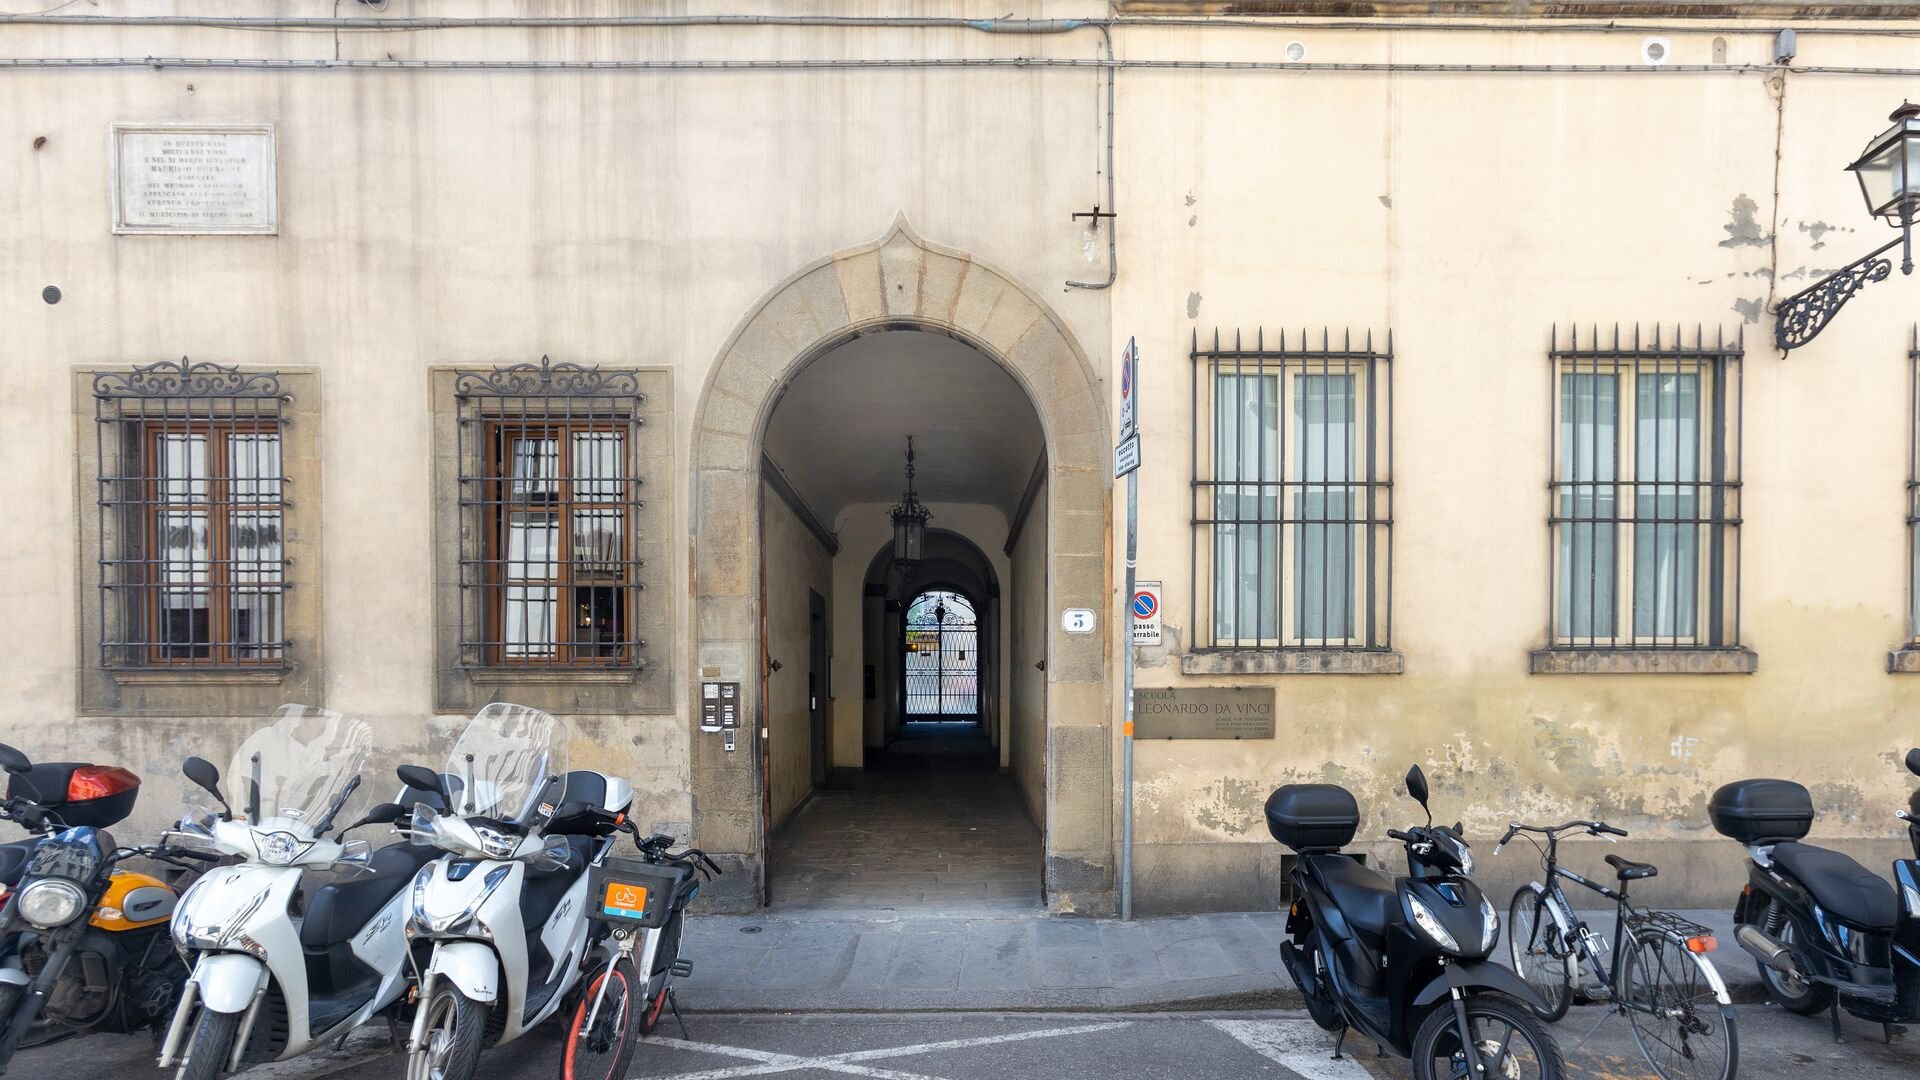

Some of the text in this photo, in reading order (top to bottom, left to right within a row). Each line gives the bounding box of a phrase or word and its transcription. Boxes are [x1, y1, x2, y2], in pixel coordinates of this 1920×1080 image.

[1074, 614, 1083, 628] 5
[1138, 691, 1176, 700] SCUOLA
[1137, 703, 1270, 714] LEONARDO DA VINCI
